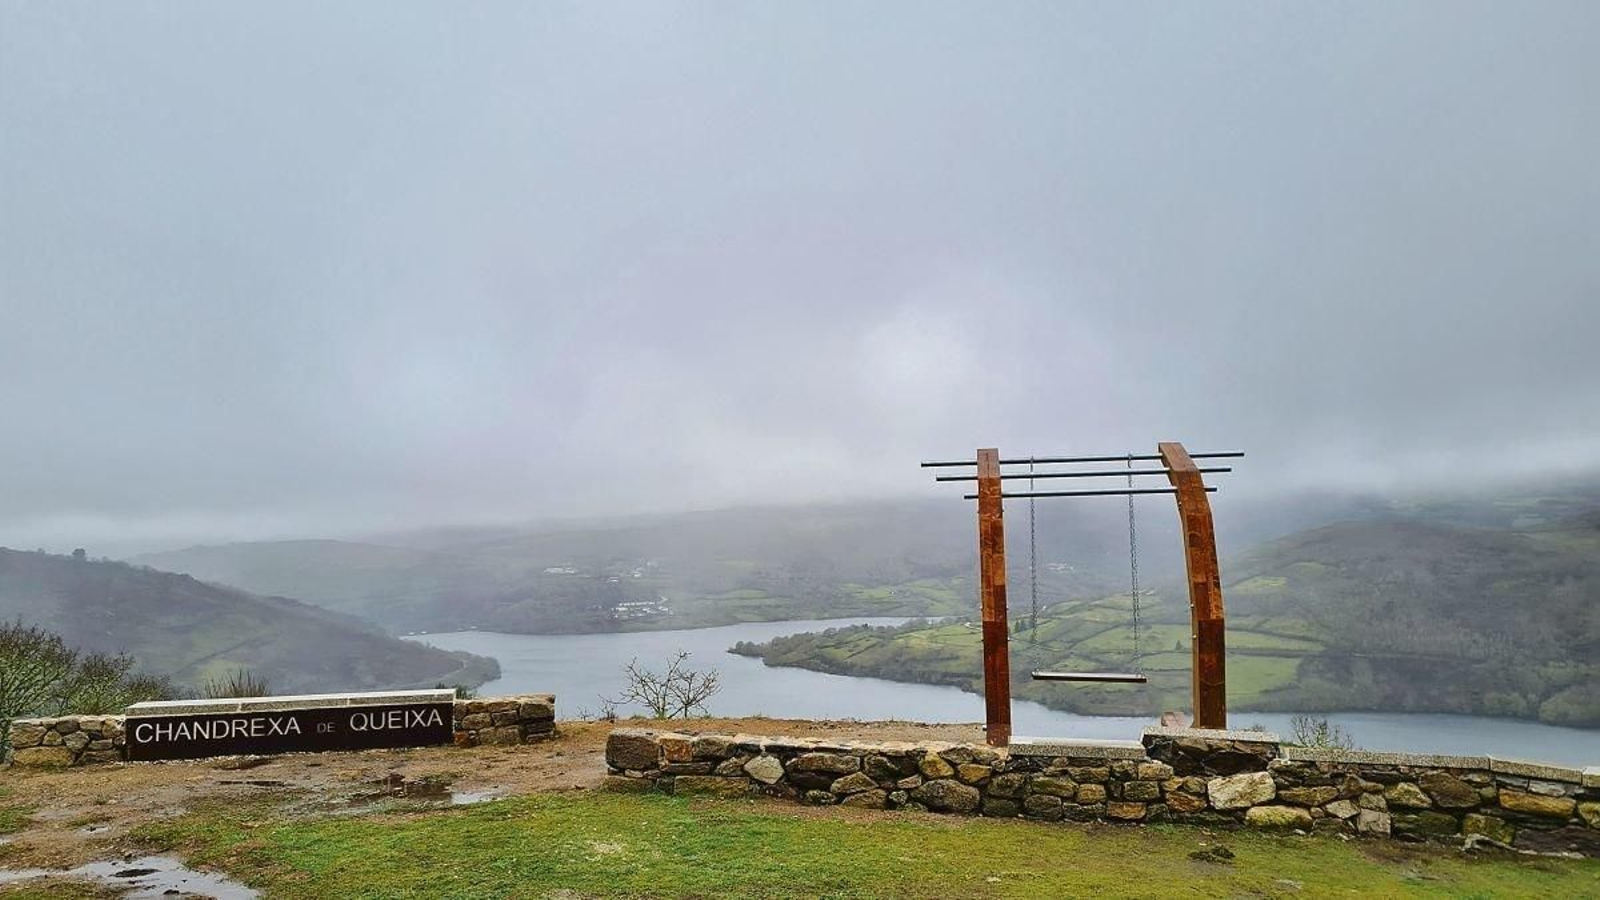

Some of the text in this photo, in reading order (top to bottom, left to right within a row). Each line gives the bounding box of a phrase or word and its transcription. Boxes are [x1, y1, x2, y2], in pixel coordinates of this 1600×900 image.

[135, 708, 444, 743] CHANDREXA DE QUEIXA
